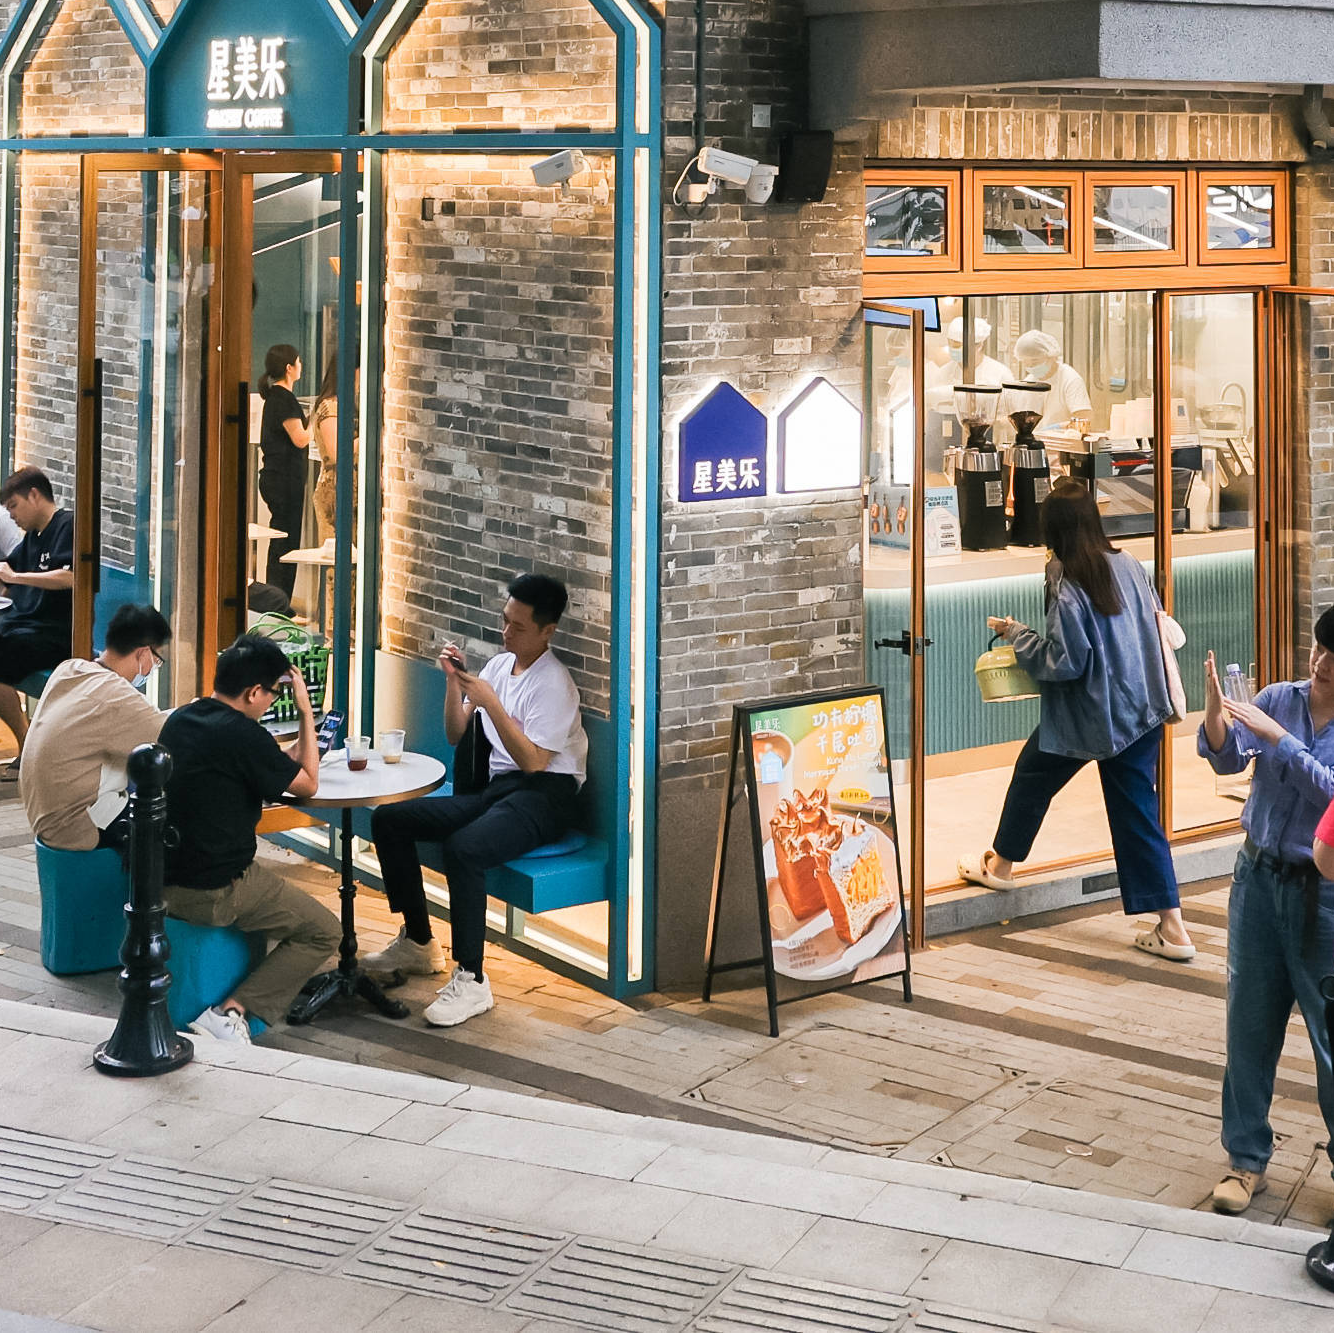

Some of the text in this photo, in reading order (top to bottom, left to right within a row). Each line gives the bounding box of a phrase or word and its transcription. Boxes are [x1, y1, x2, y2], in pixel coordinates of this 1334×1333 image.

[207, 36, 286, 101] 星美乐
[692, 458, 760, 495] 星美乐
